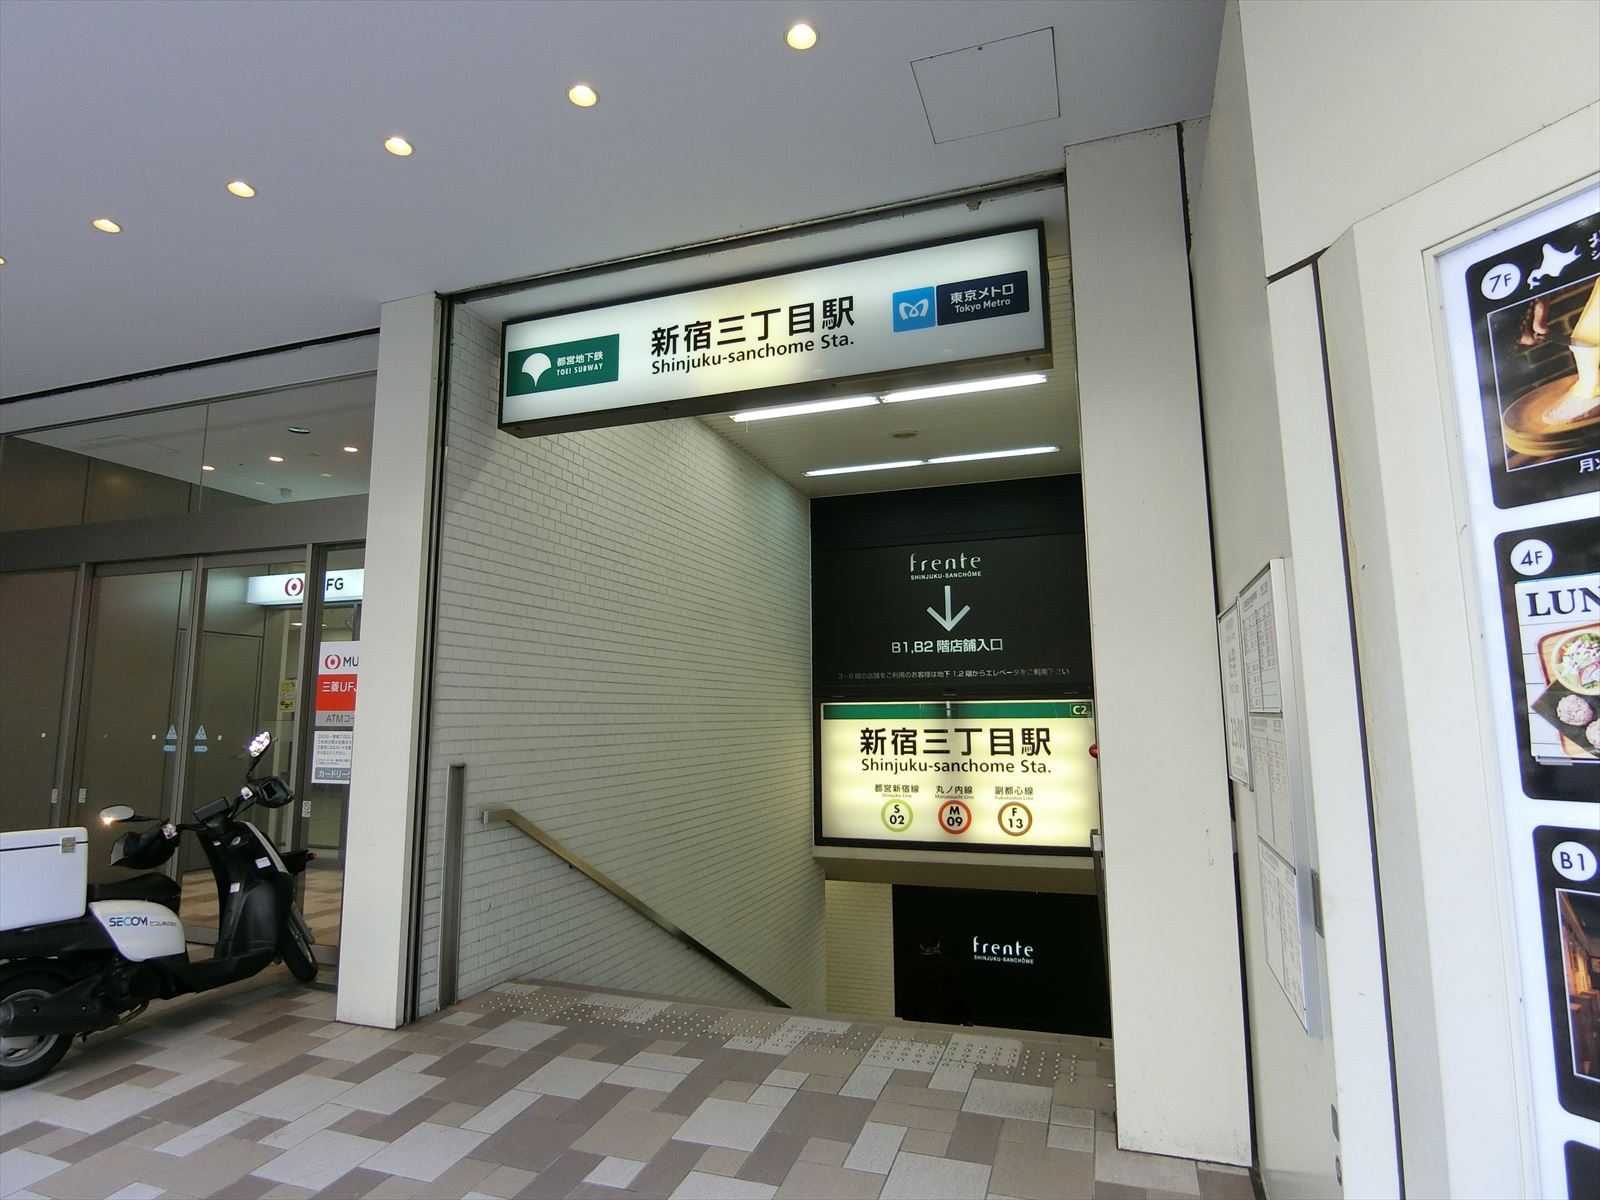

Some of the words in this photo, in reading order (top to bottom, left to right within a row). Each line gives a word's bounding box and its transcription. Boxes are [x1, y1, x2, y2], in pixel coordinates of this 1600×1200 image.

[1490, 273, 1512, 293] 7F
[950, 284, 1014, 305] 東京メトロ
[954, 302, 981, 315] Tokyo
[983, 298, 1010, 310] Metro
[651, 295, 855, 357] 新宿三丁目駅
[557, 351, 604, 367] 都営地下鉄
[652, 340, 814, 375] Shinjuku-sanchome
[821, 334, 854, 349] Sta.
[557, 368, 572, 376] TOEI
[574, 363, 603, 374] SUBWAY
[910, 552, 981, 572] frente
[1520, 549, 1543, 567] 4F
[1073, 705, 1087, 715] C2
[860, 727, 1051, 757] 新宿三丁目駅
[861, 758, 1014, 775] Shinjuku-sanchome
[1020, 760, 1051, 773] Sta.
[875, 784, 919, 793] 都営新宿線
[936, 785, 973, 795] 丸ノ内線
[995, 786, 1034, 796] 副都心線
[894, 805, 901, 814] S
[949, 806, 960, 815] M
[1011, 808, 1018, 817] F
[889, 815, 905, 825] 02
[947, 817, 963, 827] 09
[1008, 818, 1023, 829] 13
[1560, 850, 1585, 871] B1
[109, 916, 148, 927] SECOM
[973, 936, 1034, 957] frente
